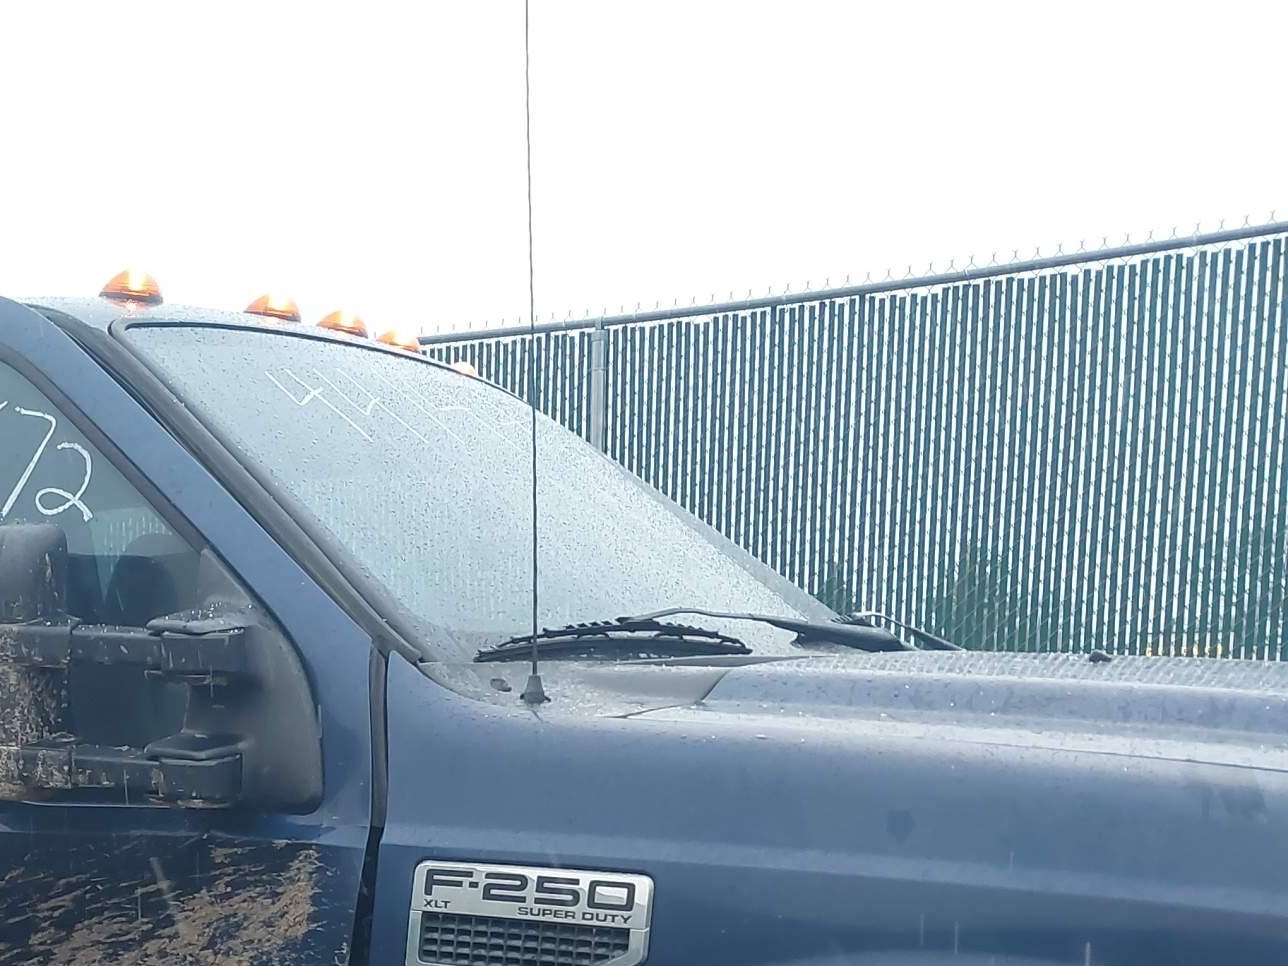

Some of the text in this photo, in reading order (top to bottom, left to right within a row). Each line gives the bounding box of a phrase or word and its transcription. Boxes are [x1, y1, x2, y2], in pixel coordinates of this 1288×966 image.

[424, 868, 636, 912] F-250
[423, 898, 451, 909] XLT
[518, 906, 632, 925] SUPER DUTY
